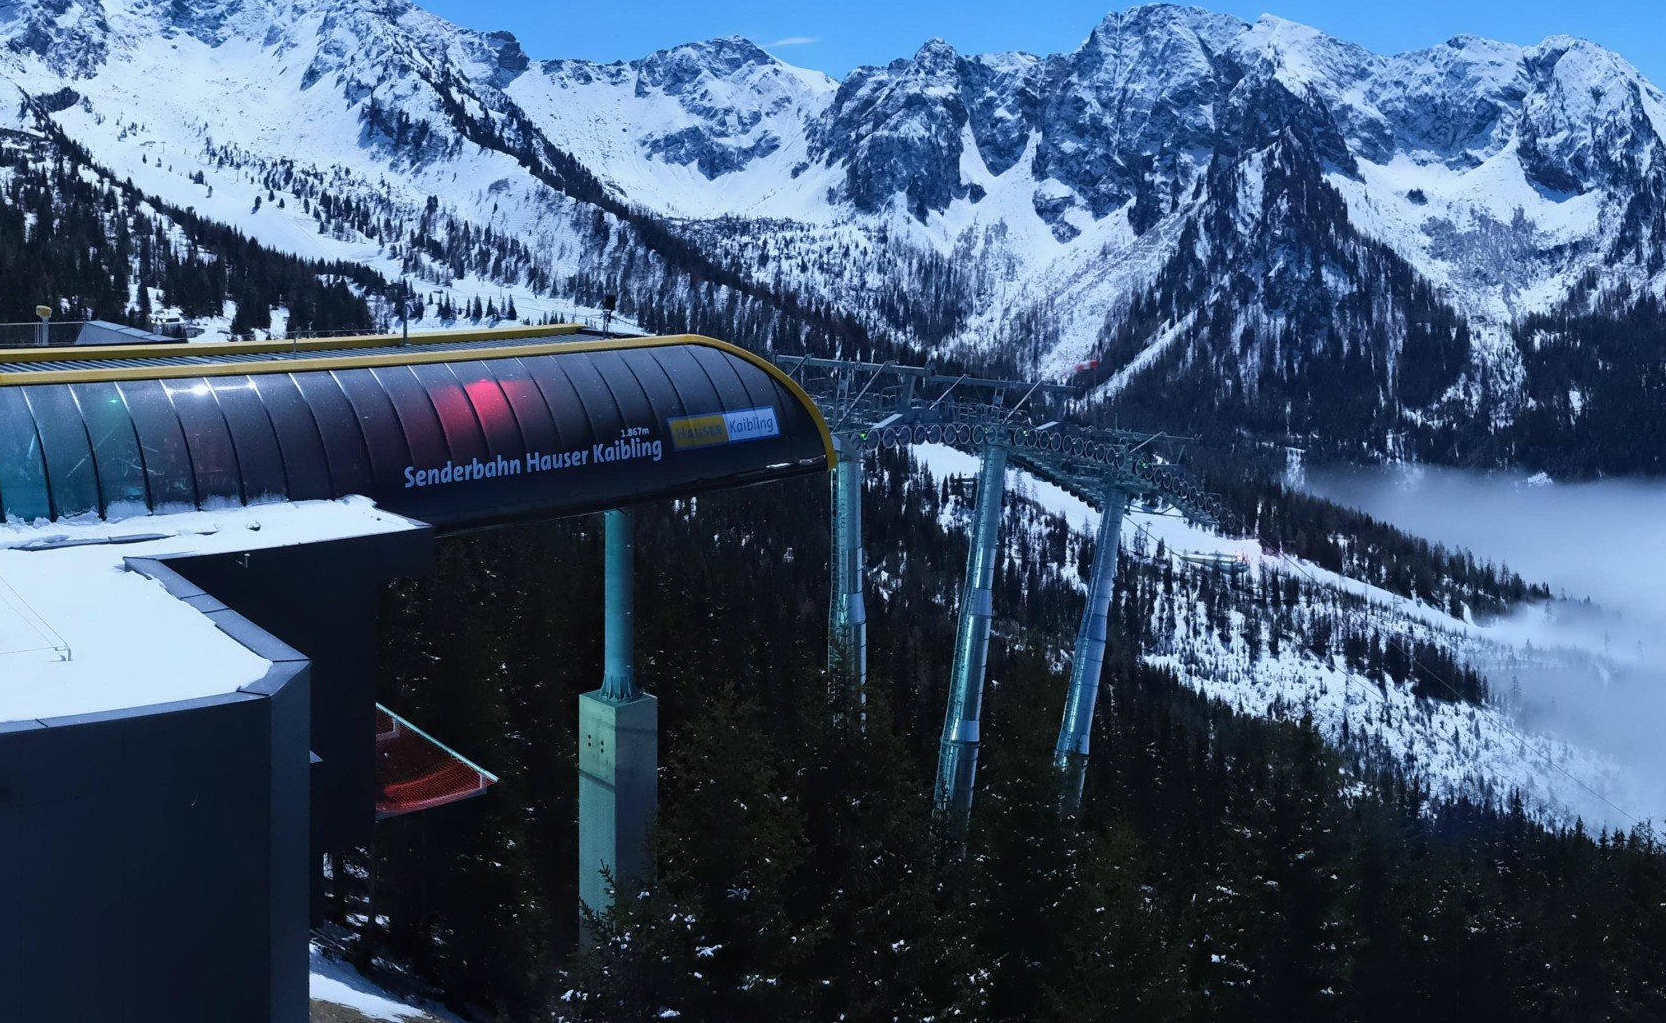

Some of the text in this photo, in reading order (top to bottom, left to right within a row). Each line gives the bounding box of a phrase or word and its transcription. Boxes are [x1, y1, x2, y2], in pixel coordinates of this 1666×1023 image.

[620, 427, 650, 438] 1.867m
[729, 417, 774, 433] Kaibling
[404, 438, 662, 488] Senderbahn Hauser Kaibling
